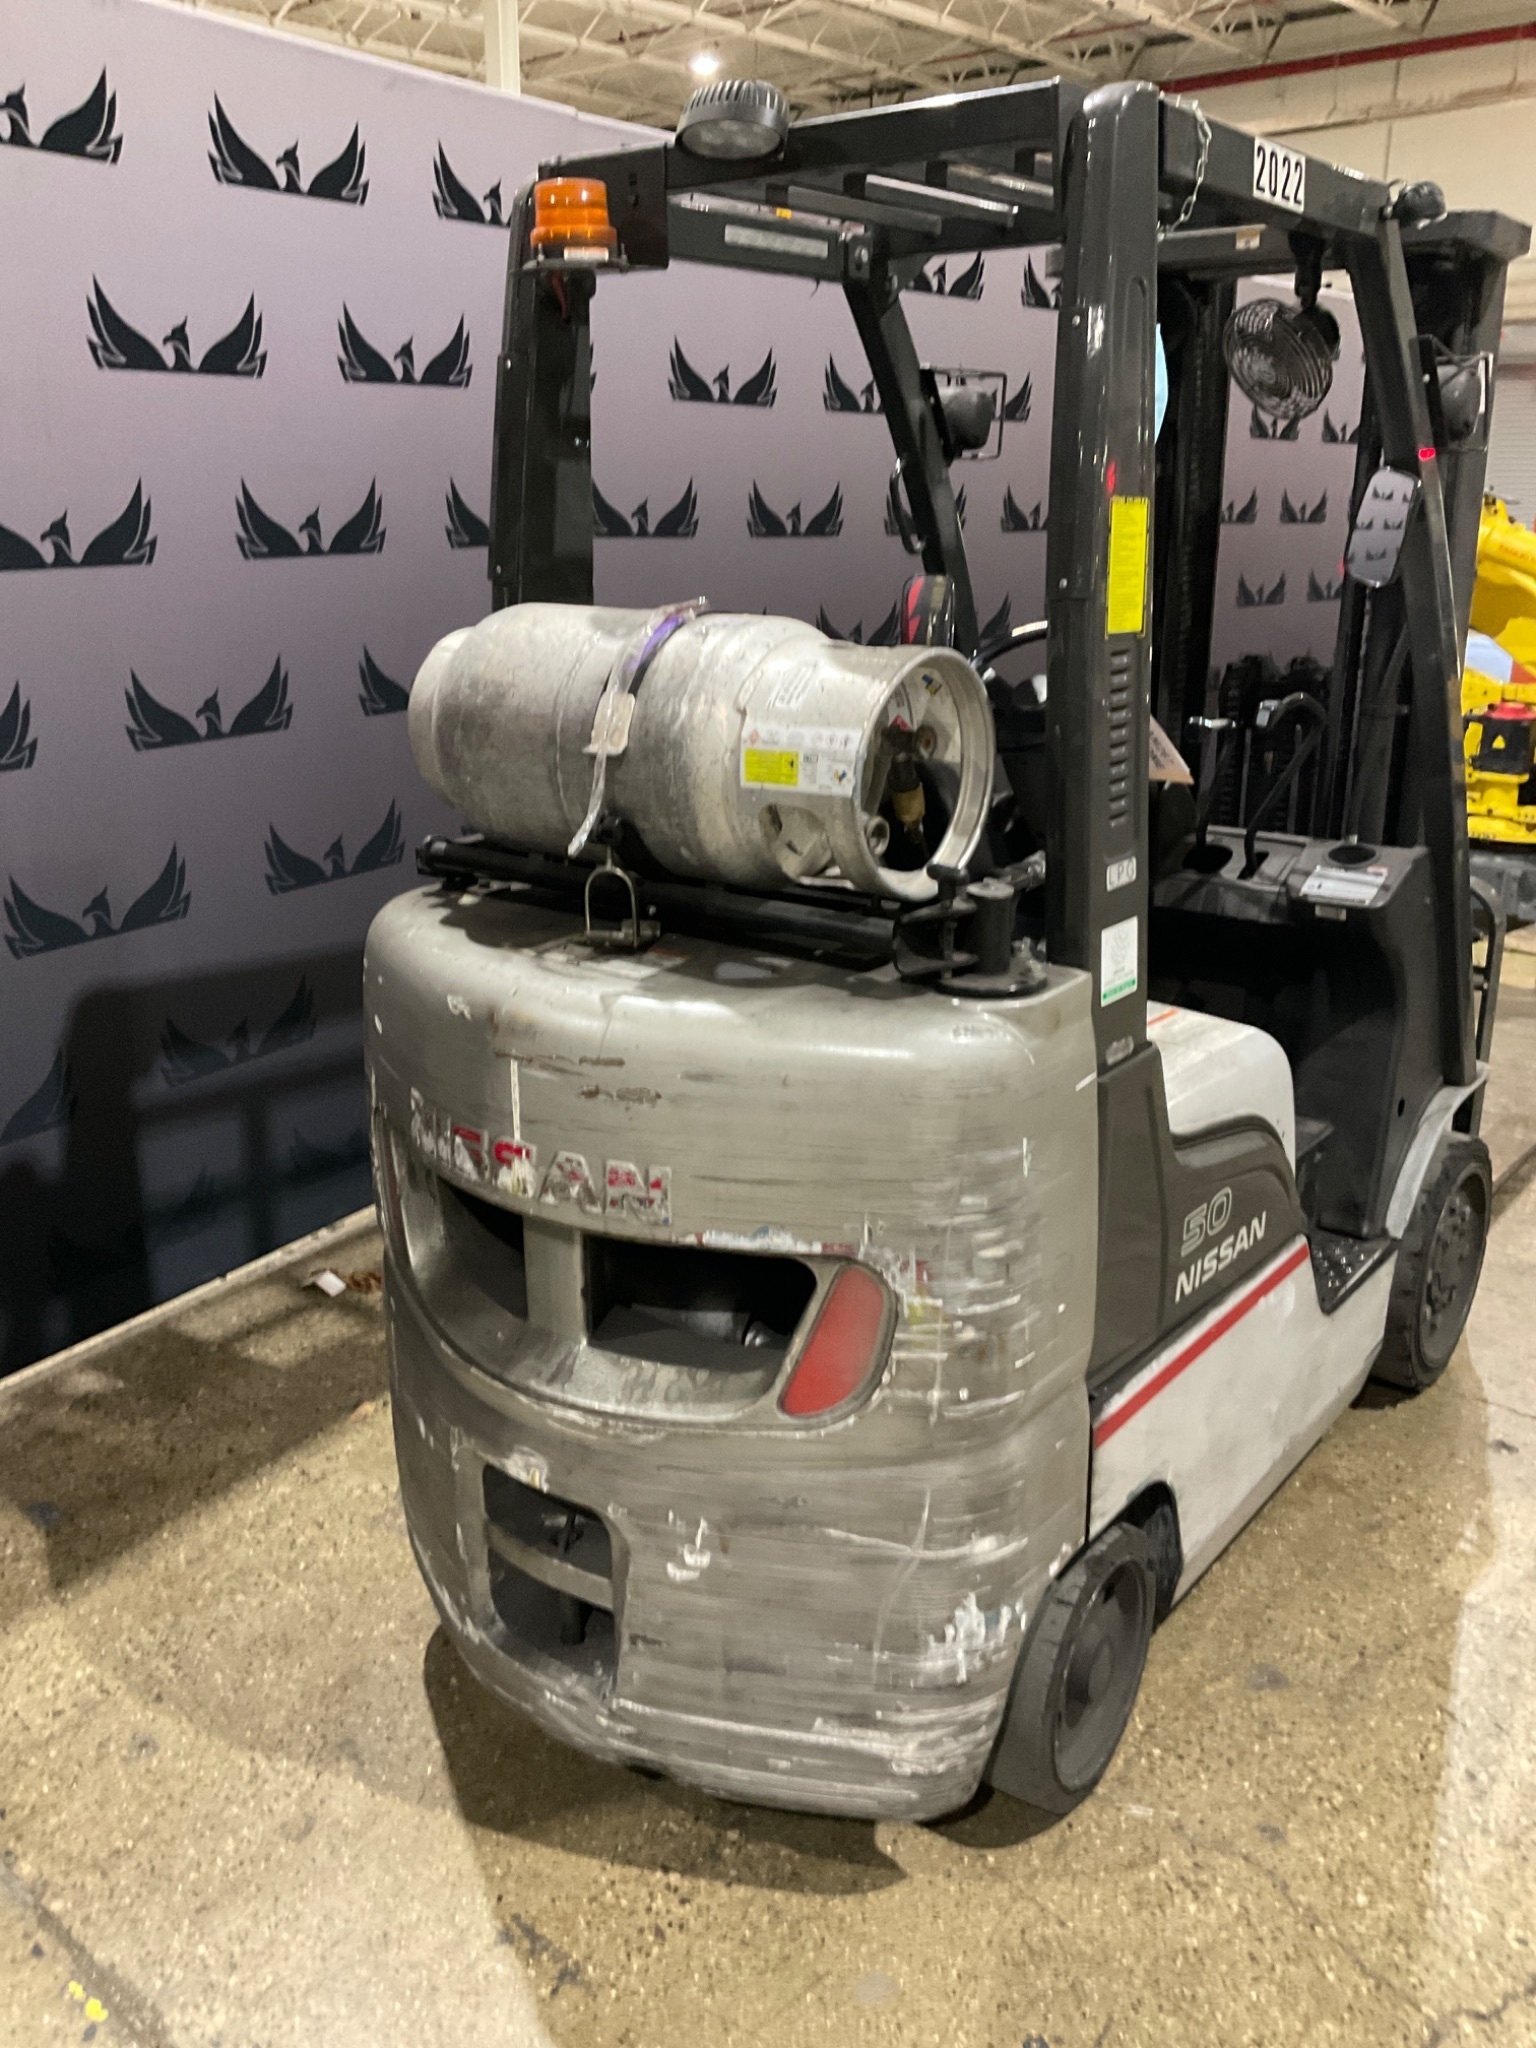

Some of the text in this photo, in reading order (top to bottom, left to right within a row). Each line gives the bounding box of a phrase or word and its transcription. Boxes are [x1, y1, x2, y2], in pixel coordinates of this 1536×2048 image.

[1255, 144, 1303, 206] 2022
[1174, 1209, 1267, 1304] NISSAN
[1180, 1186, 1233, 1258] 50
